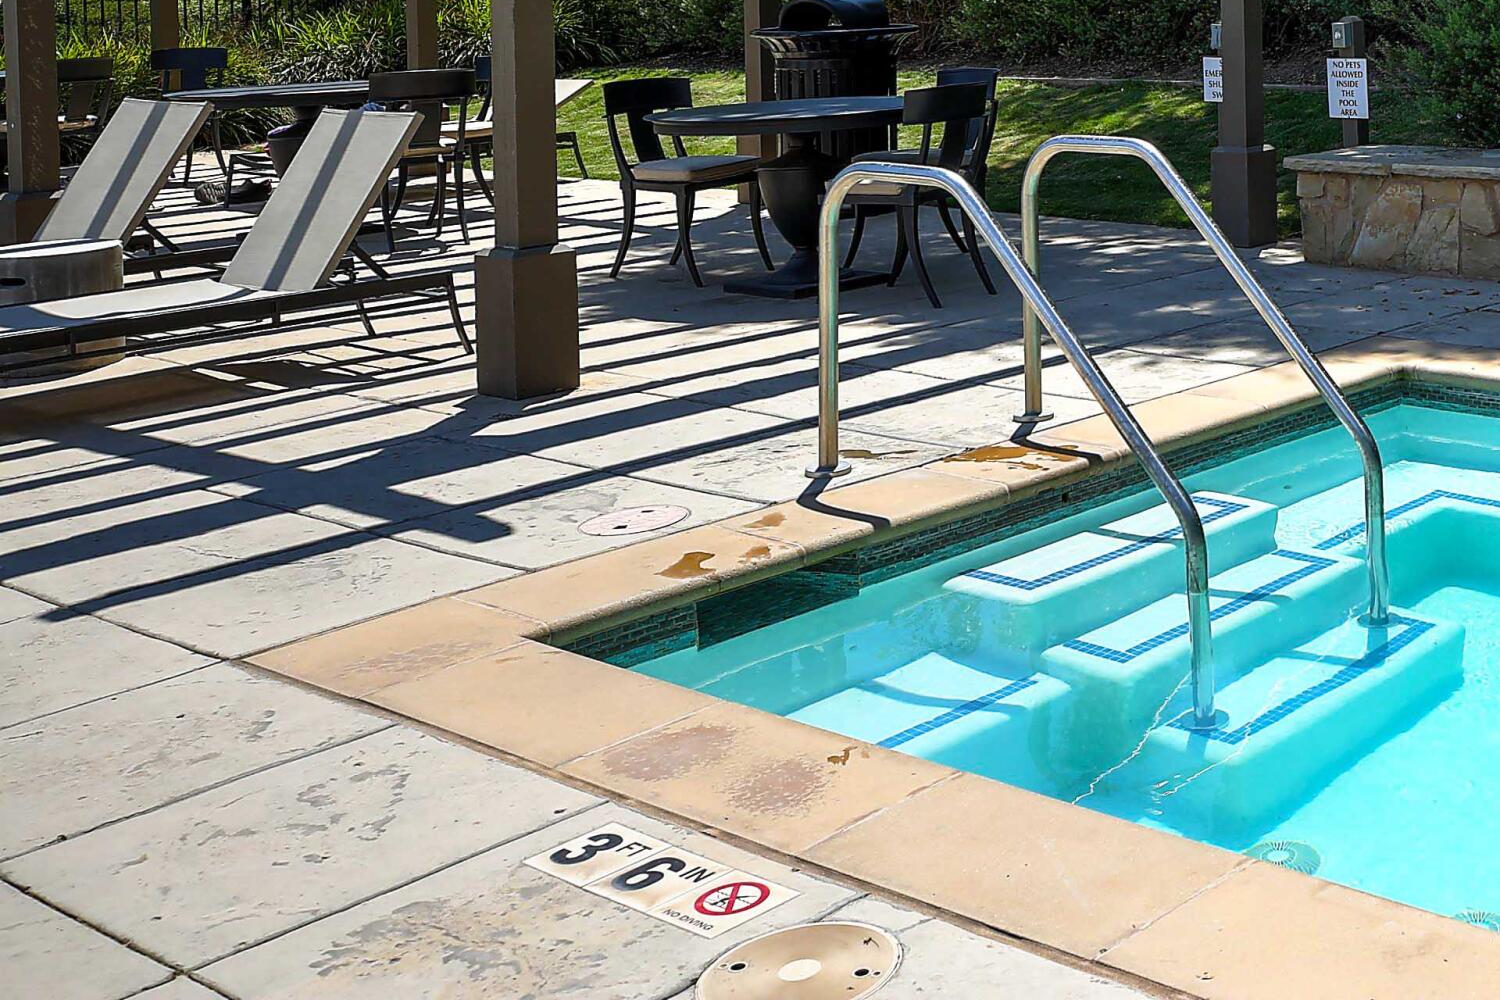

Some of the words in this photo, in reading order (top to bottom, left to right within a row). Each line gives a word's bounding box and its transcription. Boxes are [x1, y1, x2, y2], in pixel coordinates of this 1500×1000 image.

[550, 833, 623, 865] 3
[616, 842, 652, 857] FT
[611, 857, 686, 891] 6
[679, 867, 716, 883] IN
[663, 909, 681, 917] NO
[679, 915, 713, 930] DIVING
